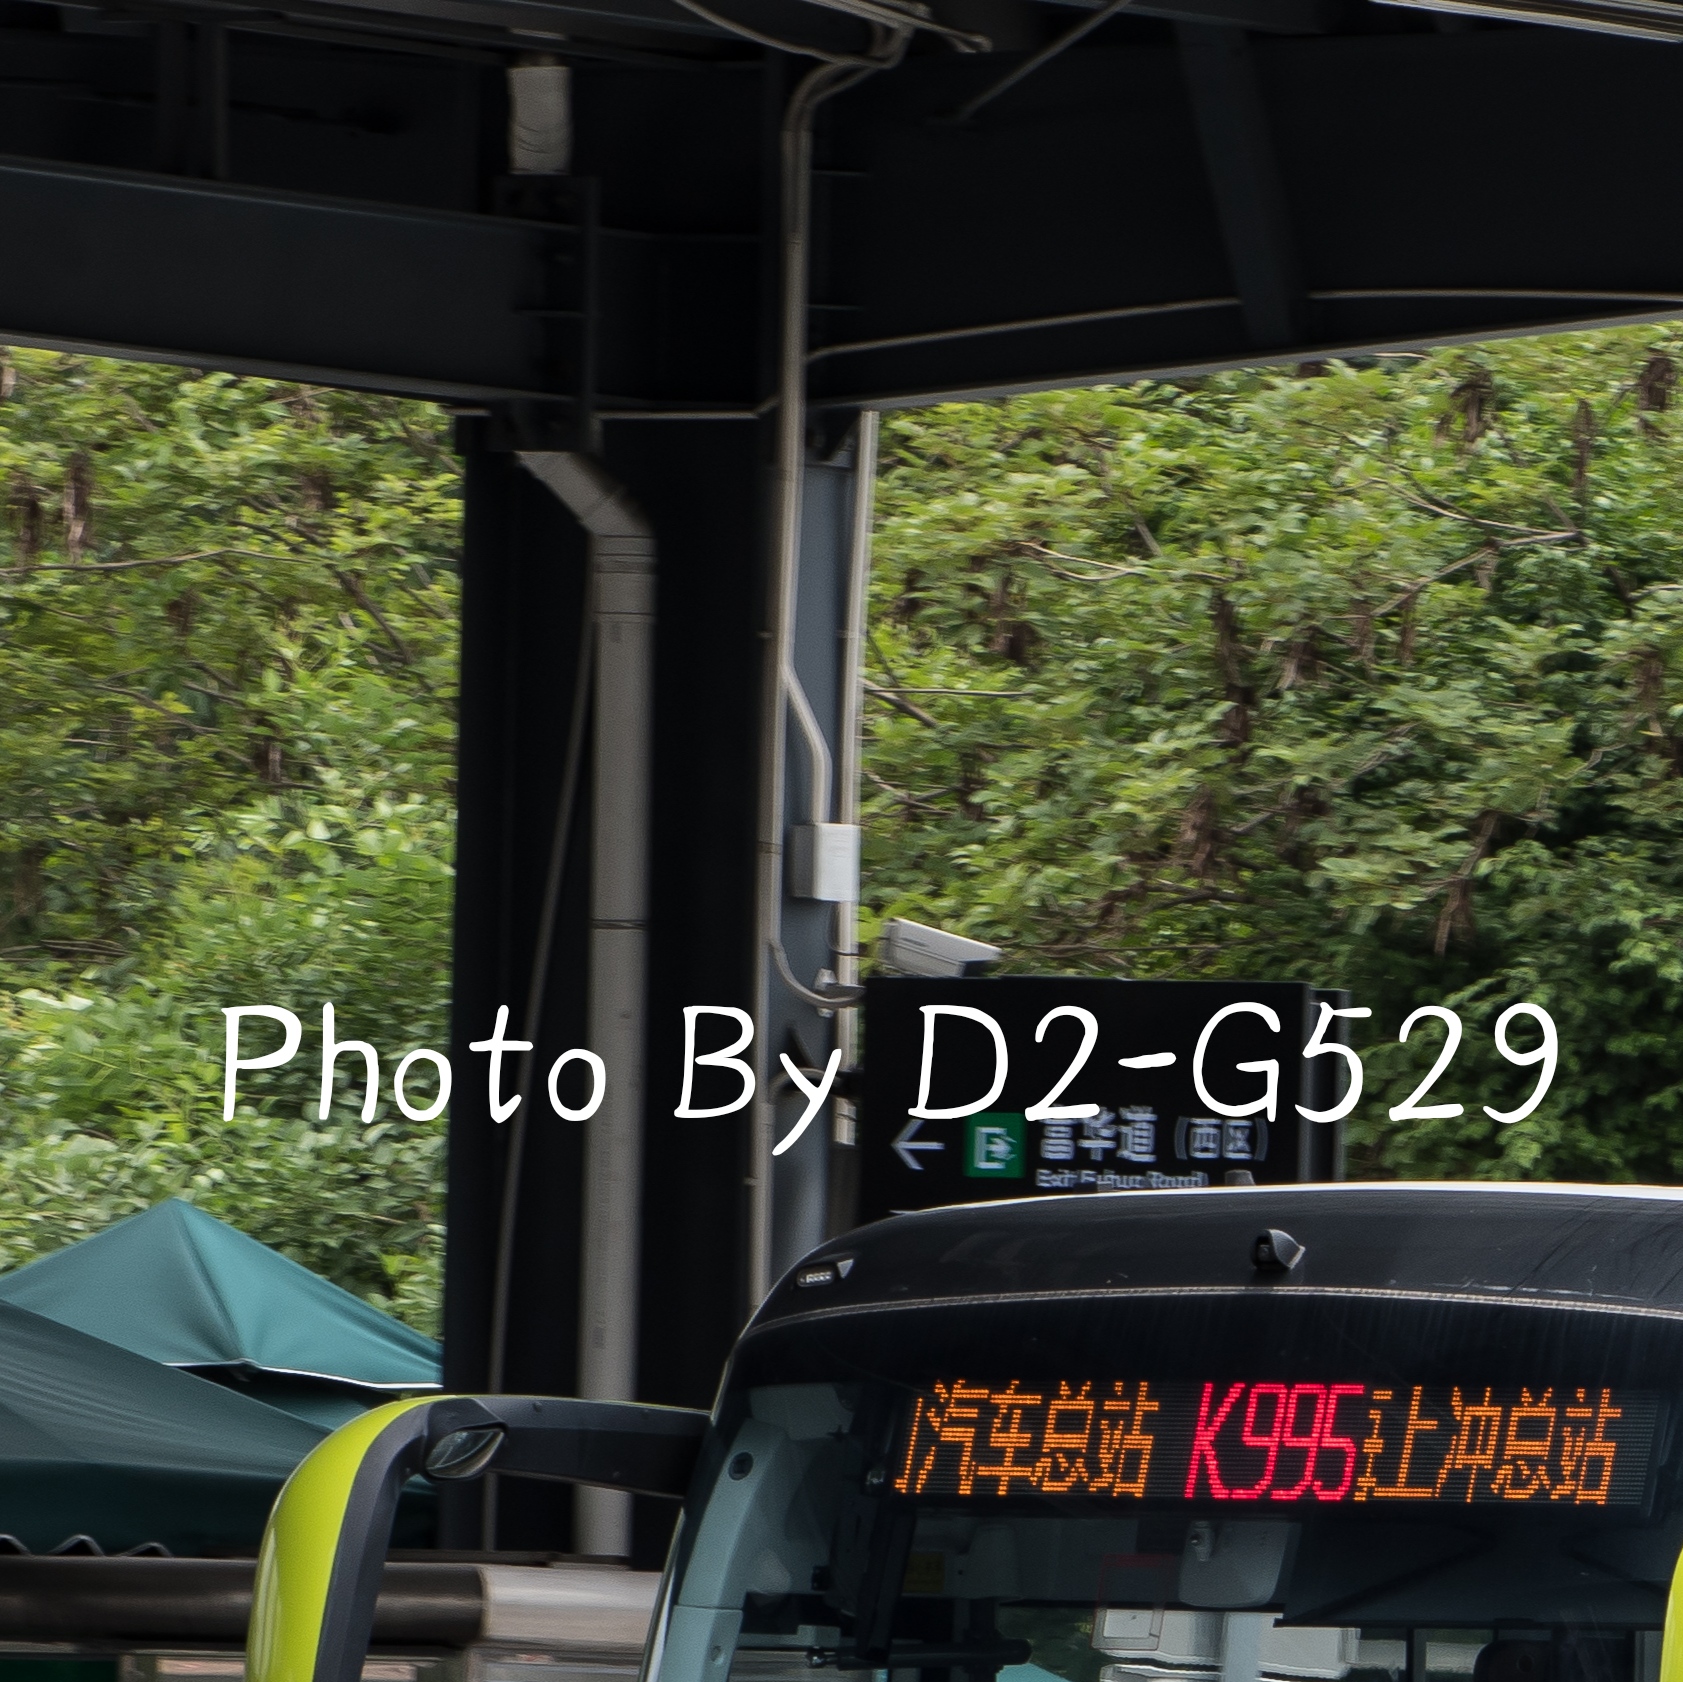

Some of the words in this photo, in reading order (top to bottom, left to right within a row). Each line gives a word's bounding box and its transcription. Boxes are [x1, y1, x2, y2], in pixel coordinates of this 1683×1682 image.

[894, 1379, 1159, 1498] 汽车总站
[1184, 1382, 1367, 1501] K995
